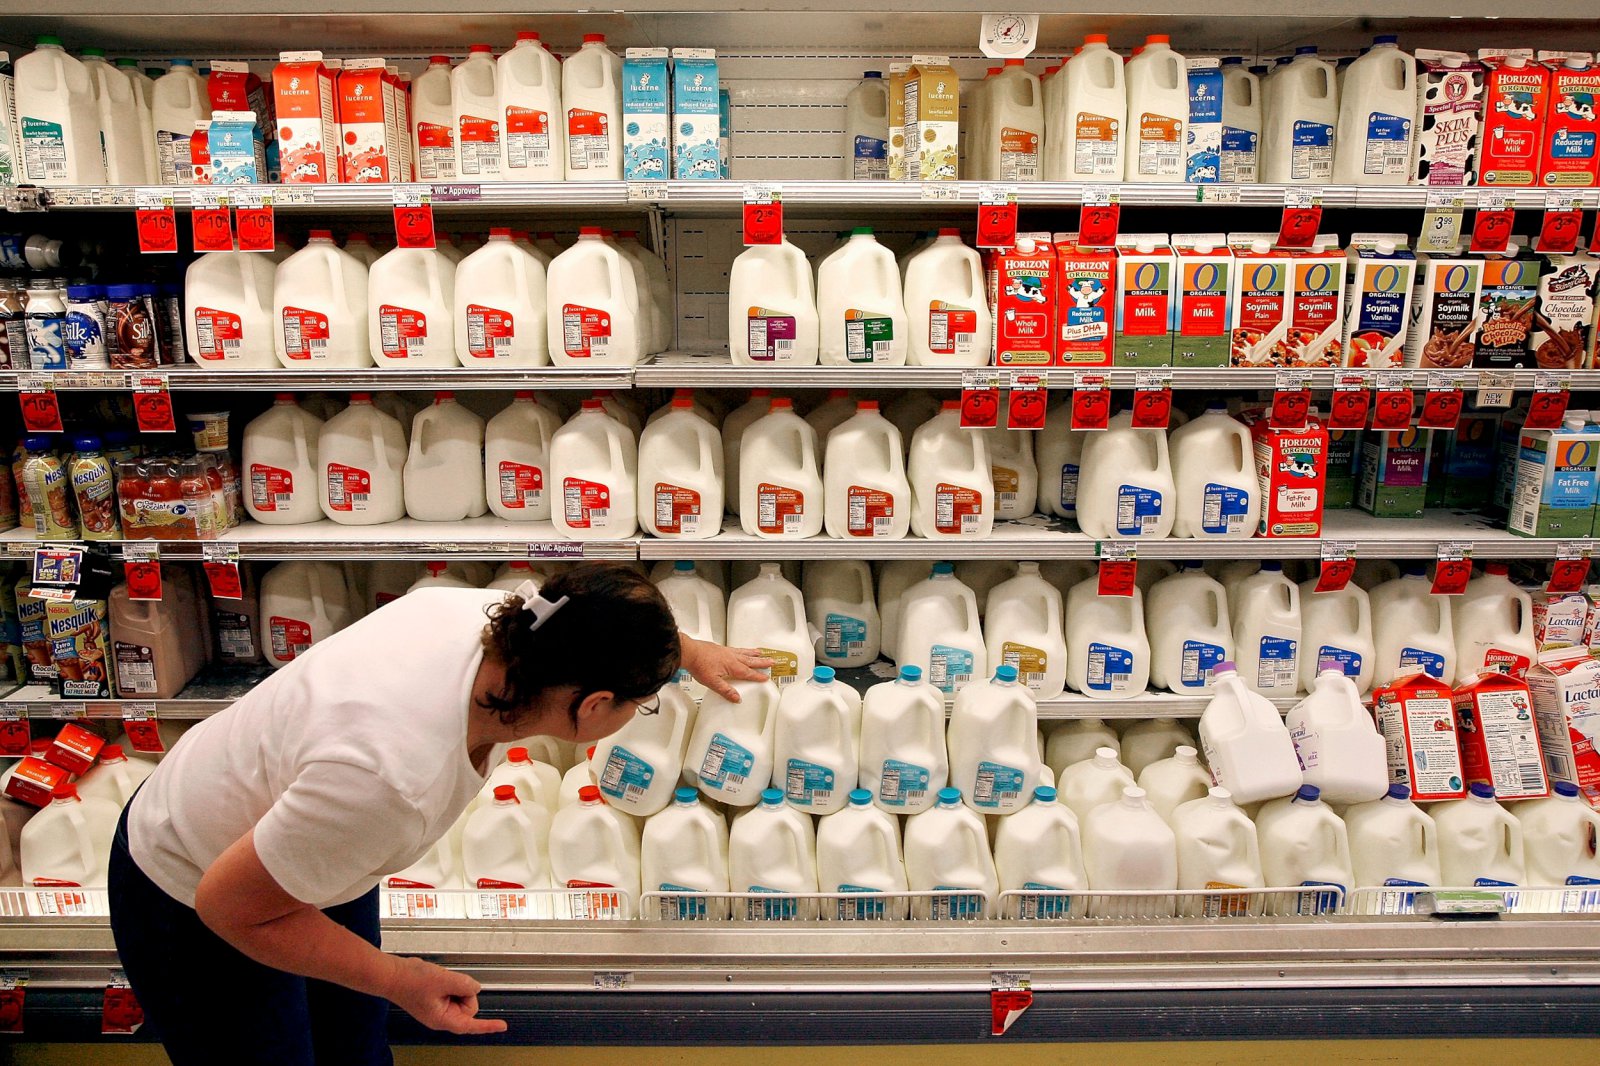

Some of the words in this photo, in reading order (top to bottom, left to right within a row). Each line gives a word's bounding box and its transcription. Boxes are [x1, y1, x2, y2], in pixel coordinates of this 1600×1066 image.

[1498, 74, 1542, 84] HORIZON
[630, 84, 660, 92] lucerne
[1501, 85, 1540, 93] ORGANIC
[1428, 103, 1451, 113] Special
[1434, 117, 1470, 135] SKIM
[1436, 131, 1467, 146] PLUS
[1504, 138, 1525, 146] Whole
[1555, 138, 1582, 146] Reduced
[1584, 138, 1594, 147] Fat
[1505, 145, 1520, 153] Milk
[1566, 145, 1582, 154] Milk
[449, 187, 479, 196] Approved
[1005, 259, 1049, 270] HORIZON
[1065, 261, 1109, 270] HORIZON
[1246, 302, 1278, 311] Soymilk
[1299, 302, 1332, 311] Soymilk
[1366, 303, 1400, 314] Soymilk
[1438, 304, 1469, 313] Soymilk
[1545, 303, 1586, 313] Chocolate
[1135, 307, 1156, 316] Milk
[1193, 309, 1214, 317] Milk
[304, 318, 317, 326] milk
[1483, 321, 1515, 331] Reduced
[1083, 324, 1100, 332] DHA
[1280, 438, 1322, 447] HORIZON
[73, 464, 107, 486] Nesquik
[553, 544, 583, 553] Approved
[19, 602, 45, 619] Nesq
[51, 608, 97, 635] Nesquik
[1548, 617, 1584, 626] Lactaid
[55, 646, 73, 655] Calcium
[1487, 654, 1518, 662] HORIZON
[65, 681, 98, 689] Chocolate
